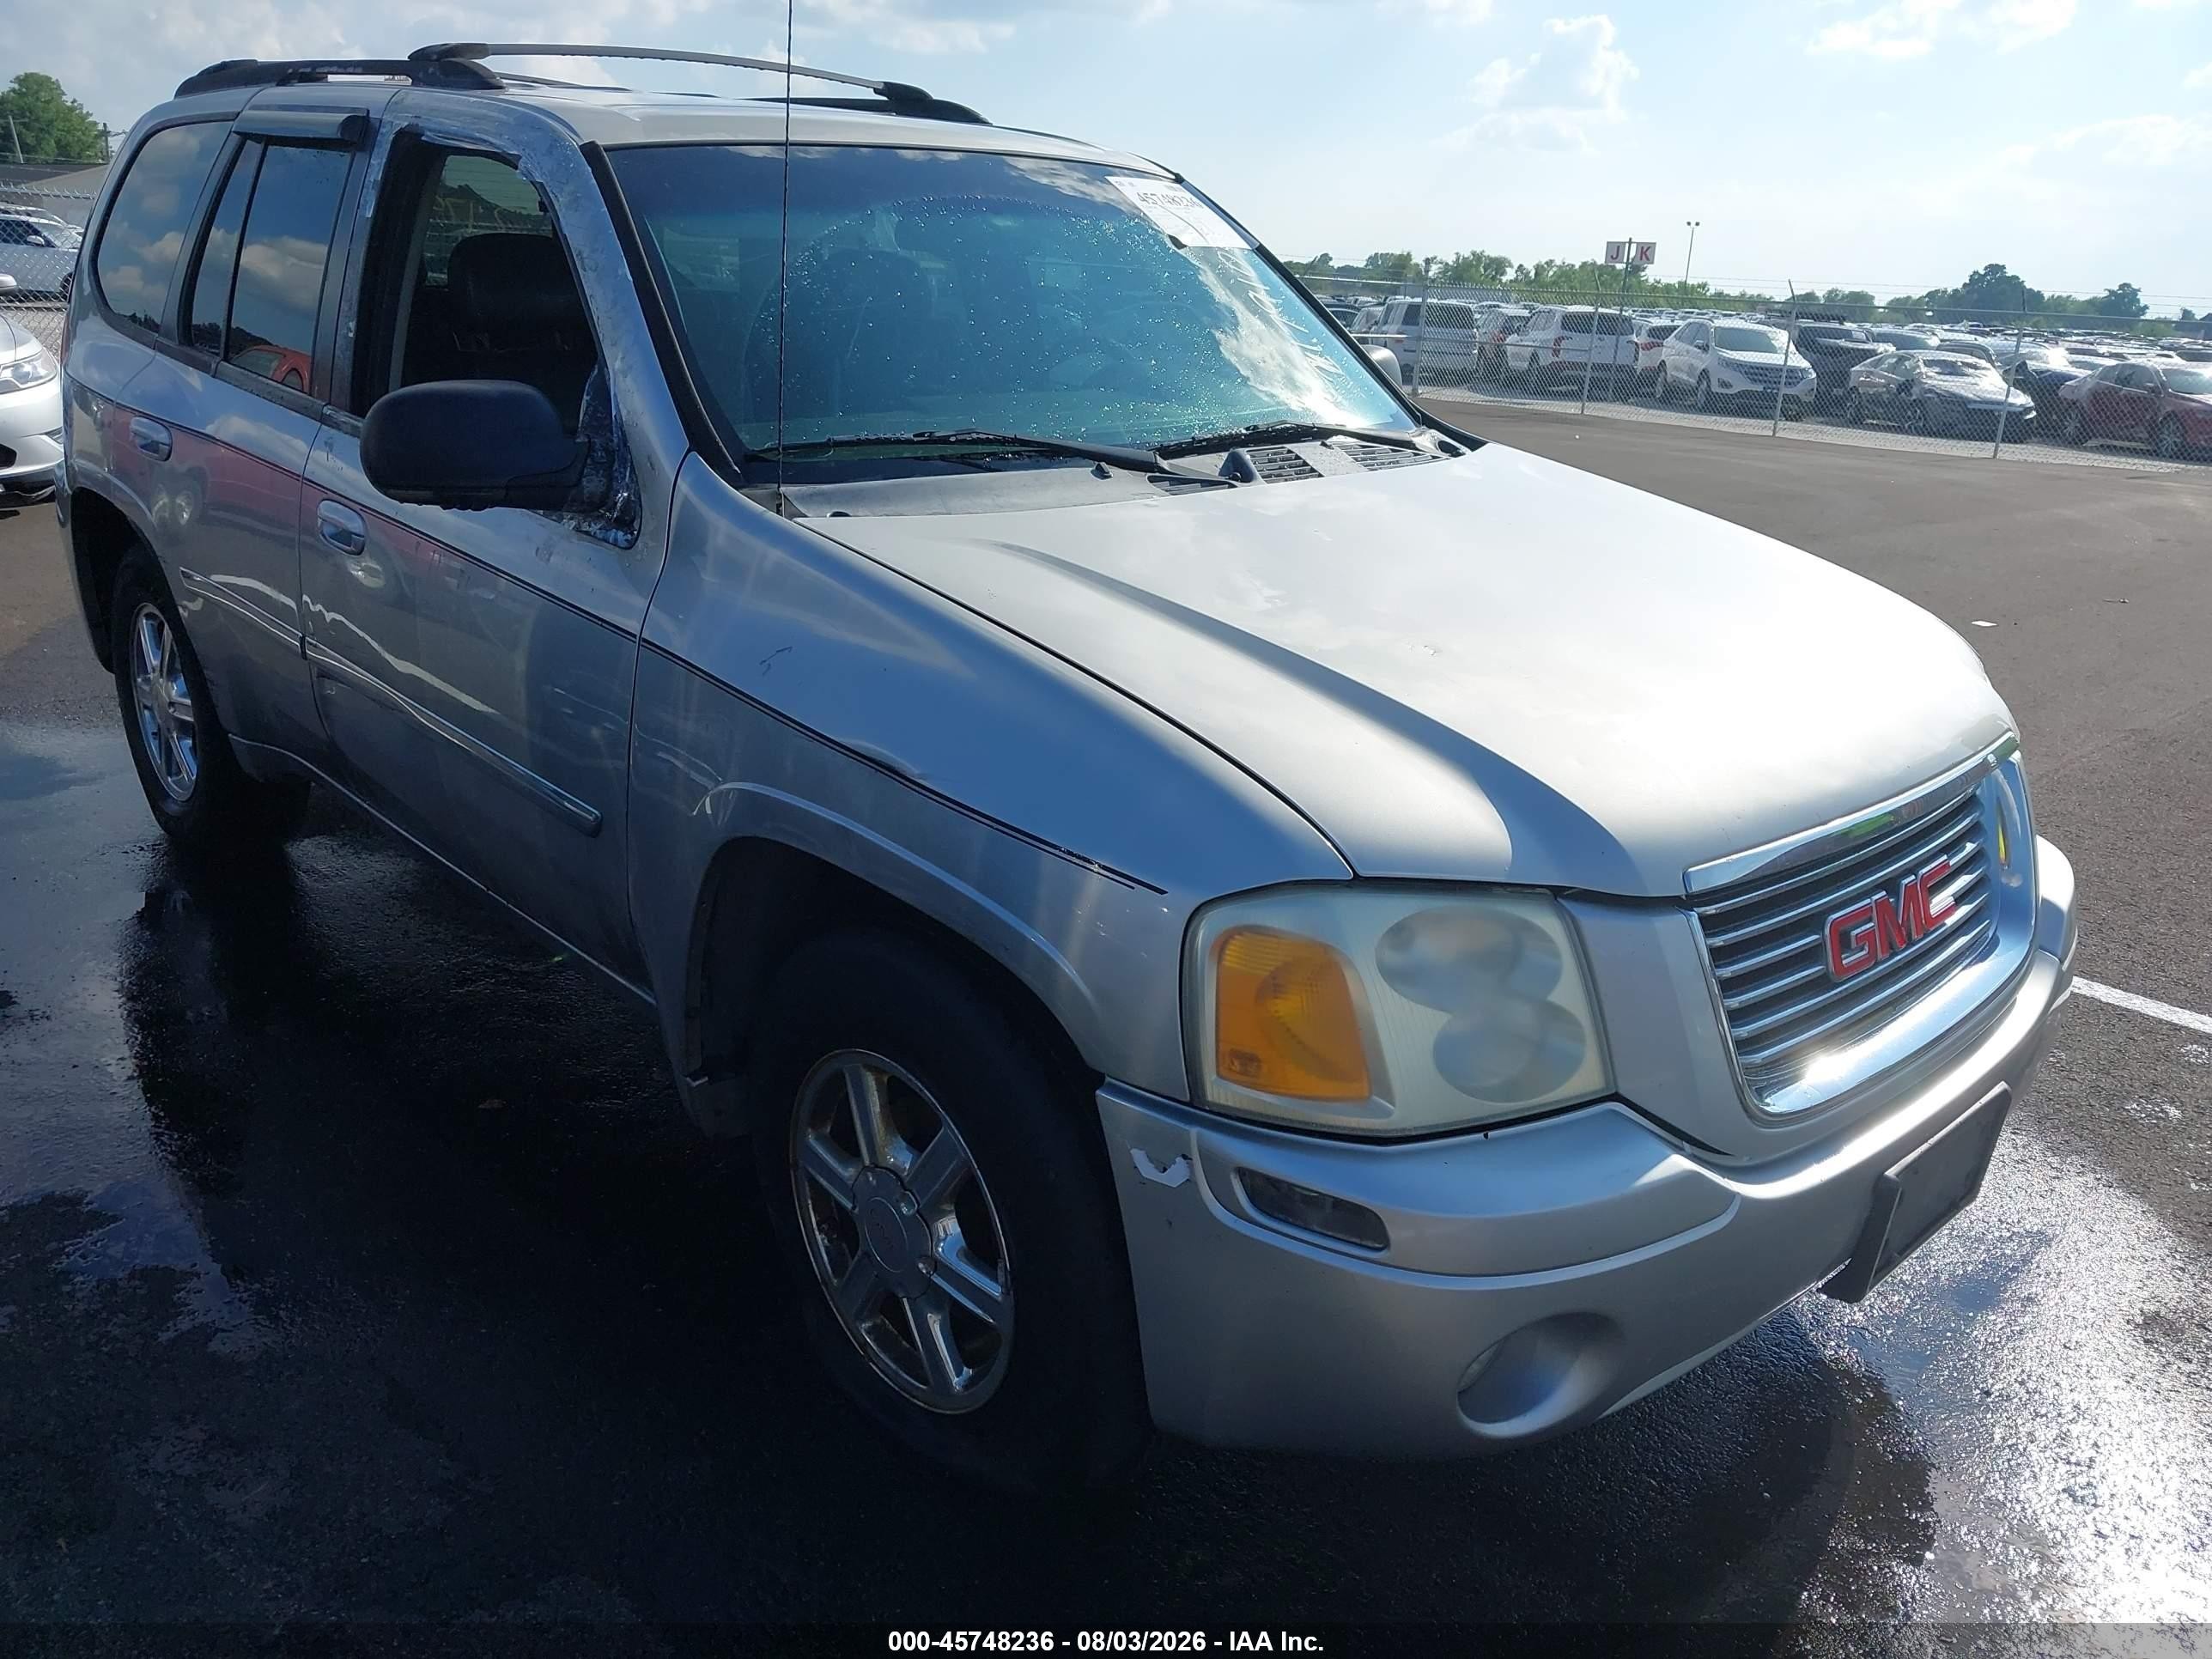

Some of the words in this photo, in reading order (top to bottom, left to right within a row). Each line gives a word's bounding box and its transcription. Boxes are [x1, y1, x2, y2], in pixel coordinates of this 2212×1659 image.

[1610, 245, 1620, 260] J
[1639, 246, 1650, 262] K
[1823, 854, 1957, 983] GMC
